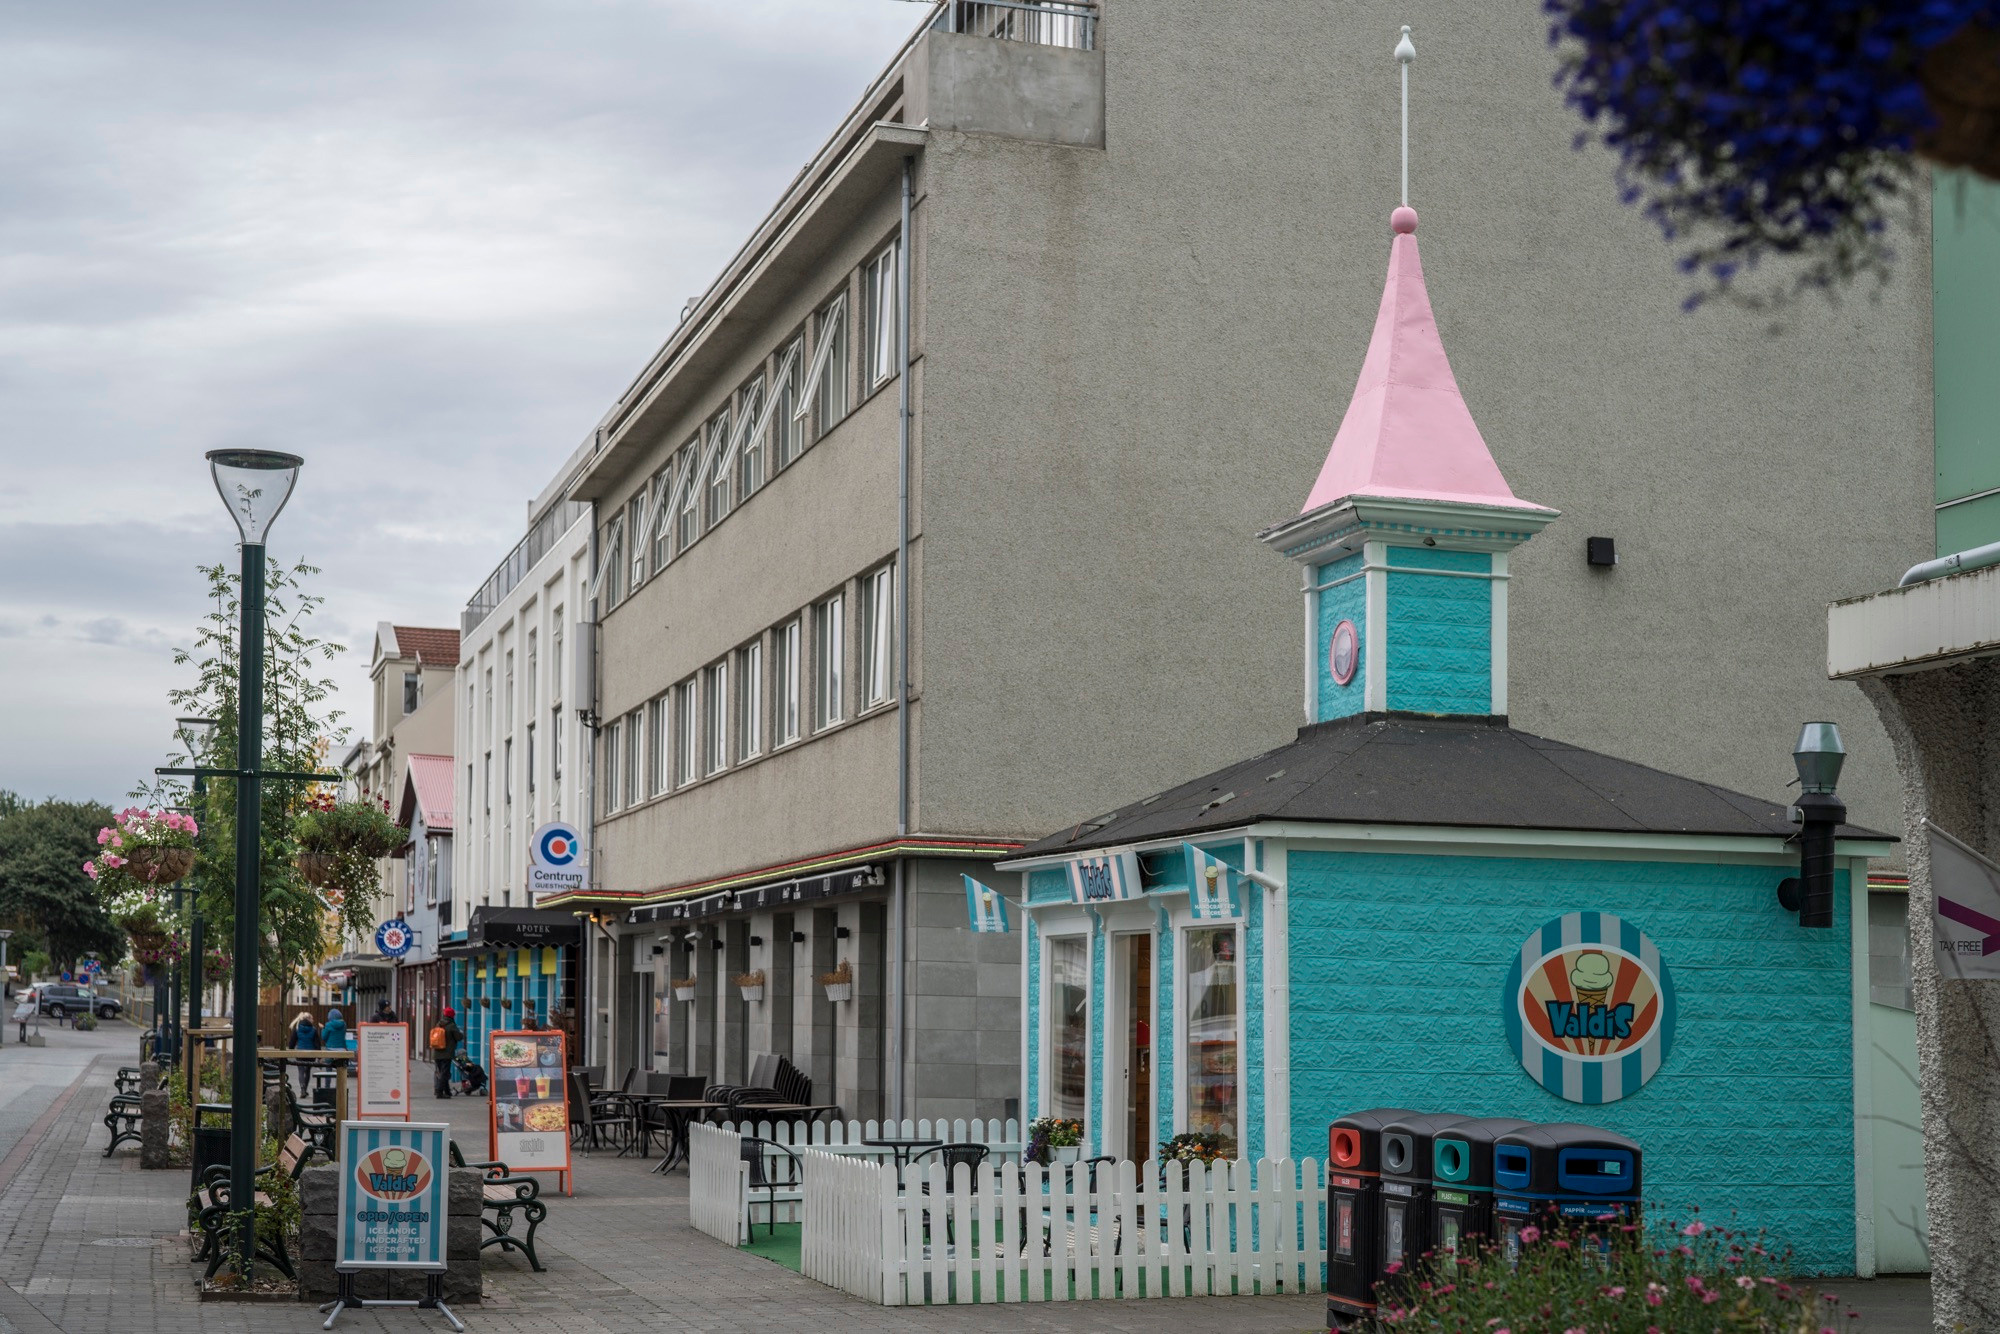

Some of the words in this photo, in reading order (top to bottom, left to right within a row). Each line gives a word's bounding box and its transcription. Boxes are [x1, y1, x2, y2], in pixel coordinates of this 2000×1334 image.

[534, 870, 583, 882] Centrum
[516, 924, 551, 933] APOTEK
[1939, 941, 1956, 951] TAX
[1958, 941, 1981, 951] FREE
[369, 1227, 417, 1235] ICELANDIC
[359, 1236, 426, 1244] HANDCRAFTED
